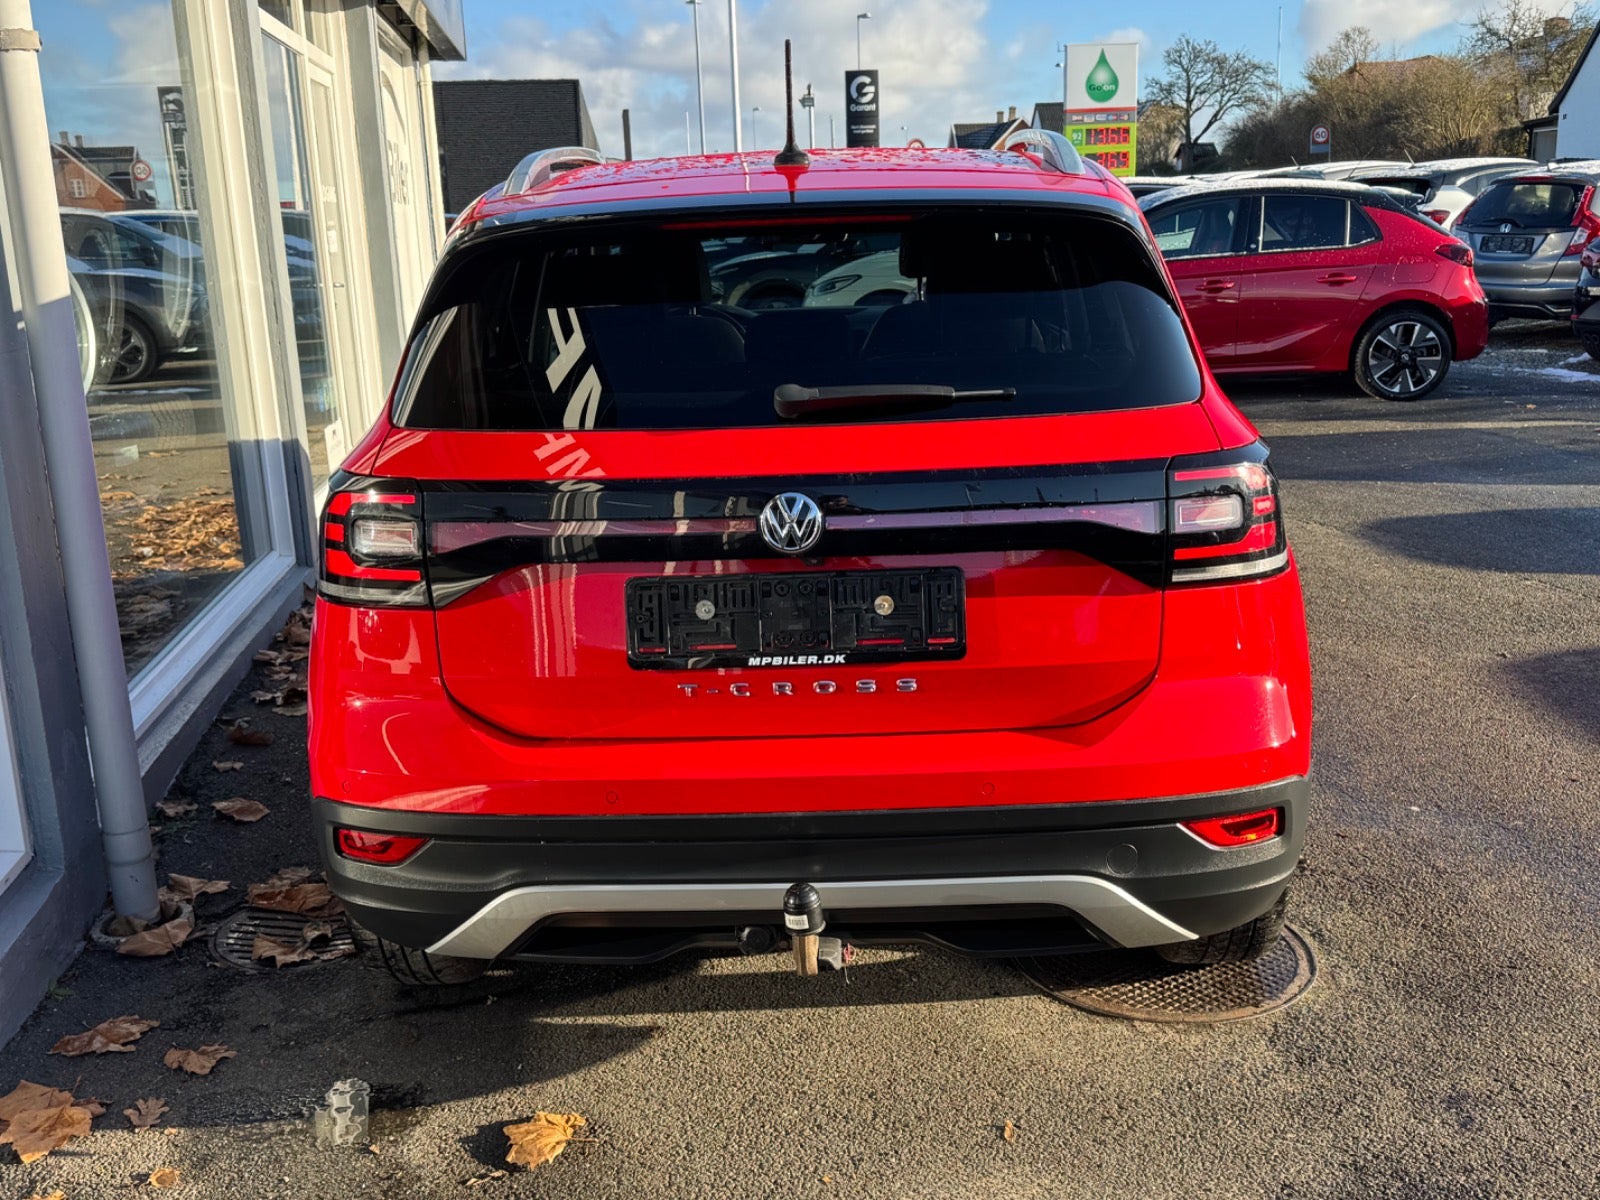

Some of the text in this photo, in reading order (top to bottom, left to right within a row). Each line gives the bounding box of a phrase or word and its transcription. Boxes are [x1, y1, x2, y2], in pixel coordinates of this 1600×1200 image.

[850, 103, 876, 111] Garant
[1315, 130, 1327, 139] 60
[747, 654, 847, 667] MPBILER.DK
[677, 678, 918, 698] T-CROSS
